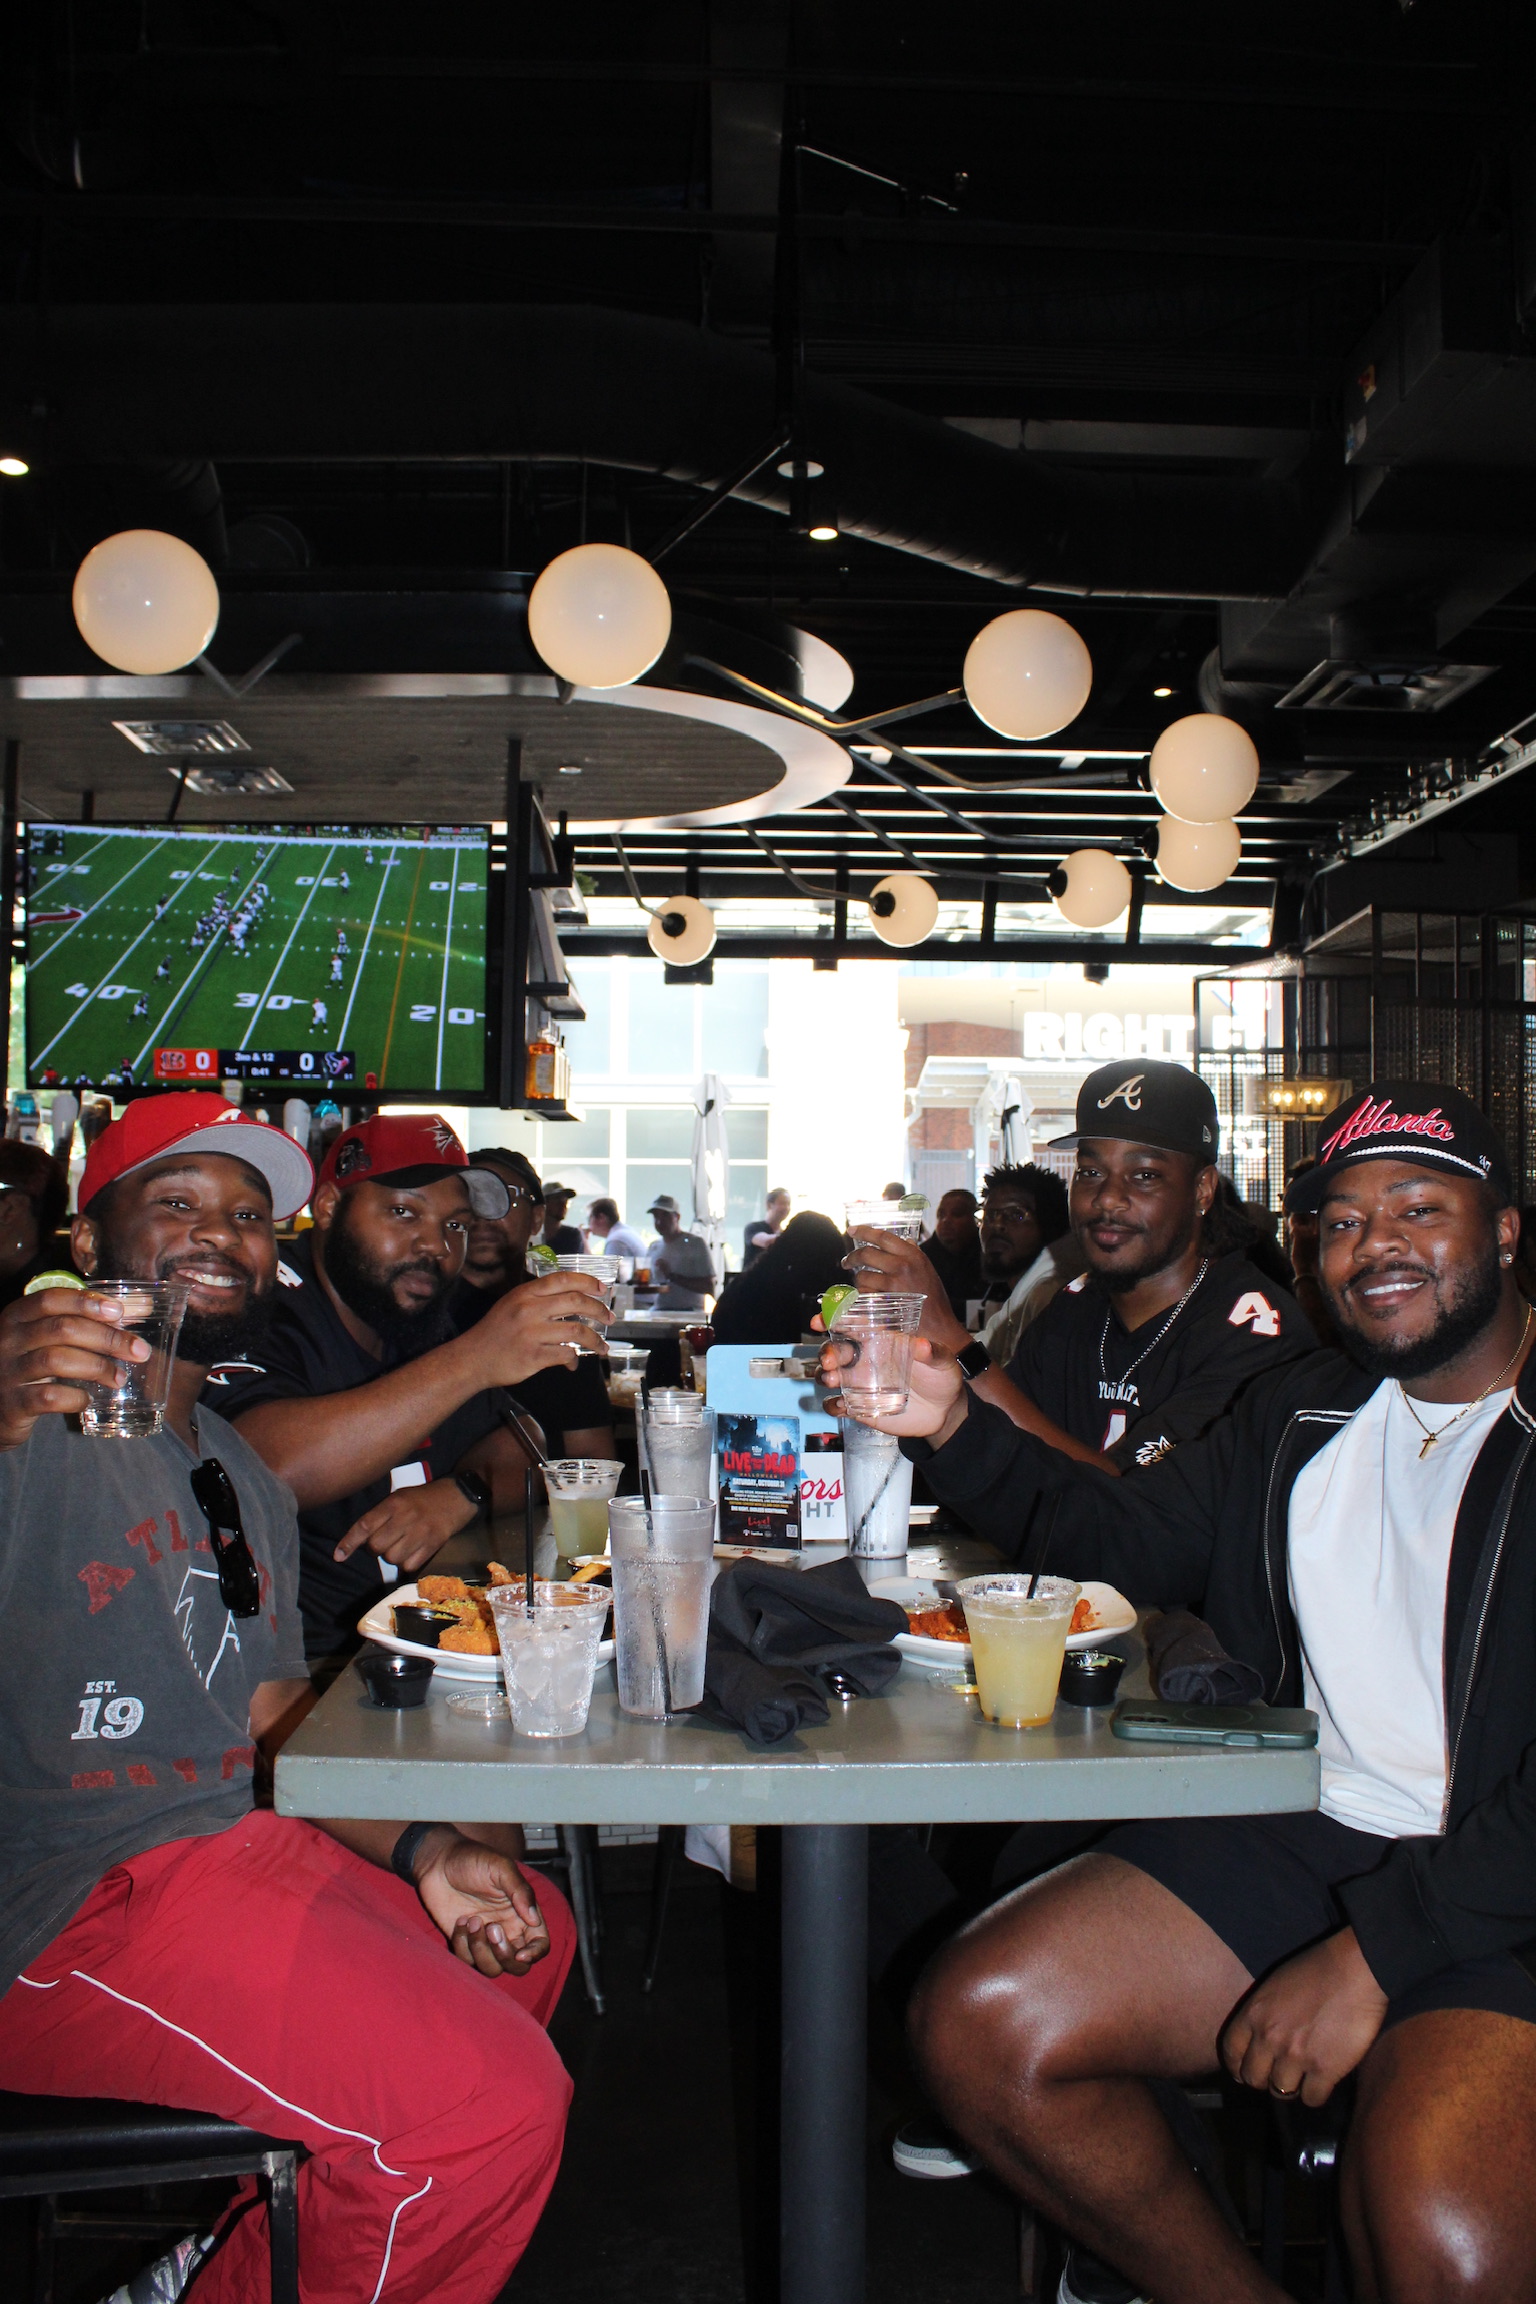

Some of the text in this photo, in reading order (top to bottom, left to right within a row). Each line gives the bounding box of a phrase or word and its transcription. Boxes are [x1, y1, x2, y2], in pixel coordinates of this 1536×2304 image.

[1023, 1011, 1195, 1058] RIGHT
[195, 1051, 210, 1070] 0
[252, 1052, 261, 1062] &
[262, 1052, 275, 1062] 12
[299, 1053, 314, 1072] 0
[251, 1067, 270, 1076] 0:41
[1097, 1074, 1145, 1111] A
[1320, 1095, 1455, 1165] Atlanta
[723, 1450, 752, 1473] LIVE
[764, 1452, 796, 1477] DEAD
[801, 1478, 844, 1500] ors
[85, 1680, 117, 1695] EST.
[70, 1696, 145, 1740] 19
